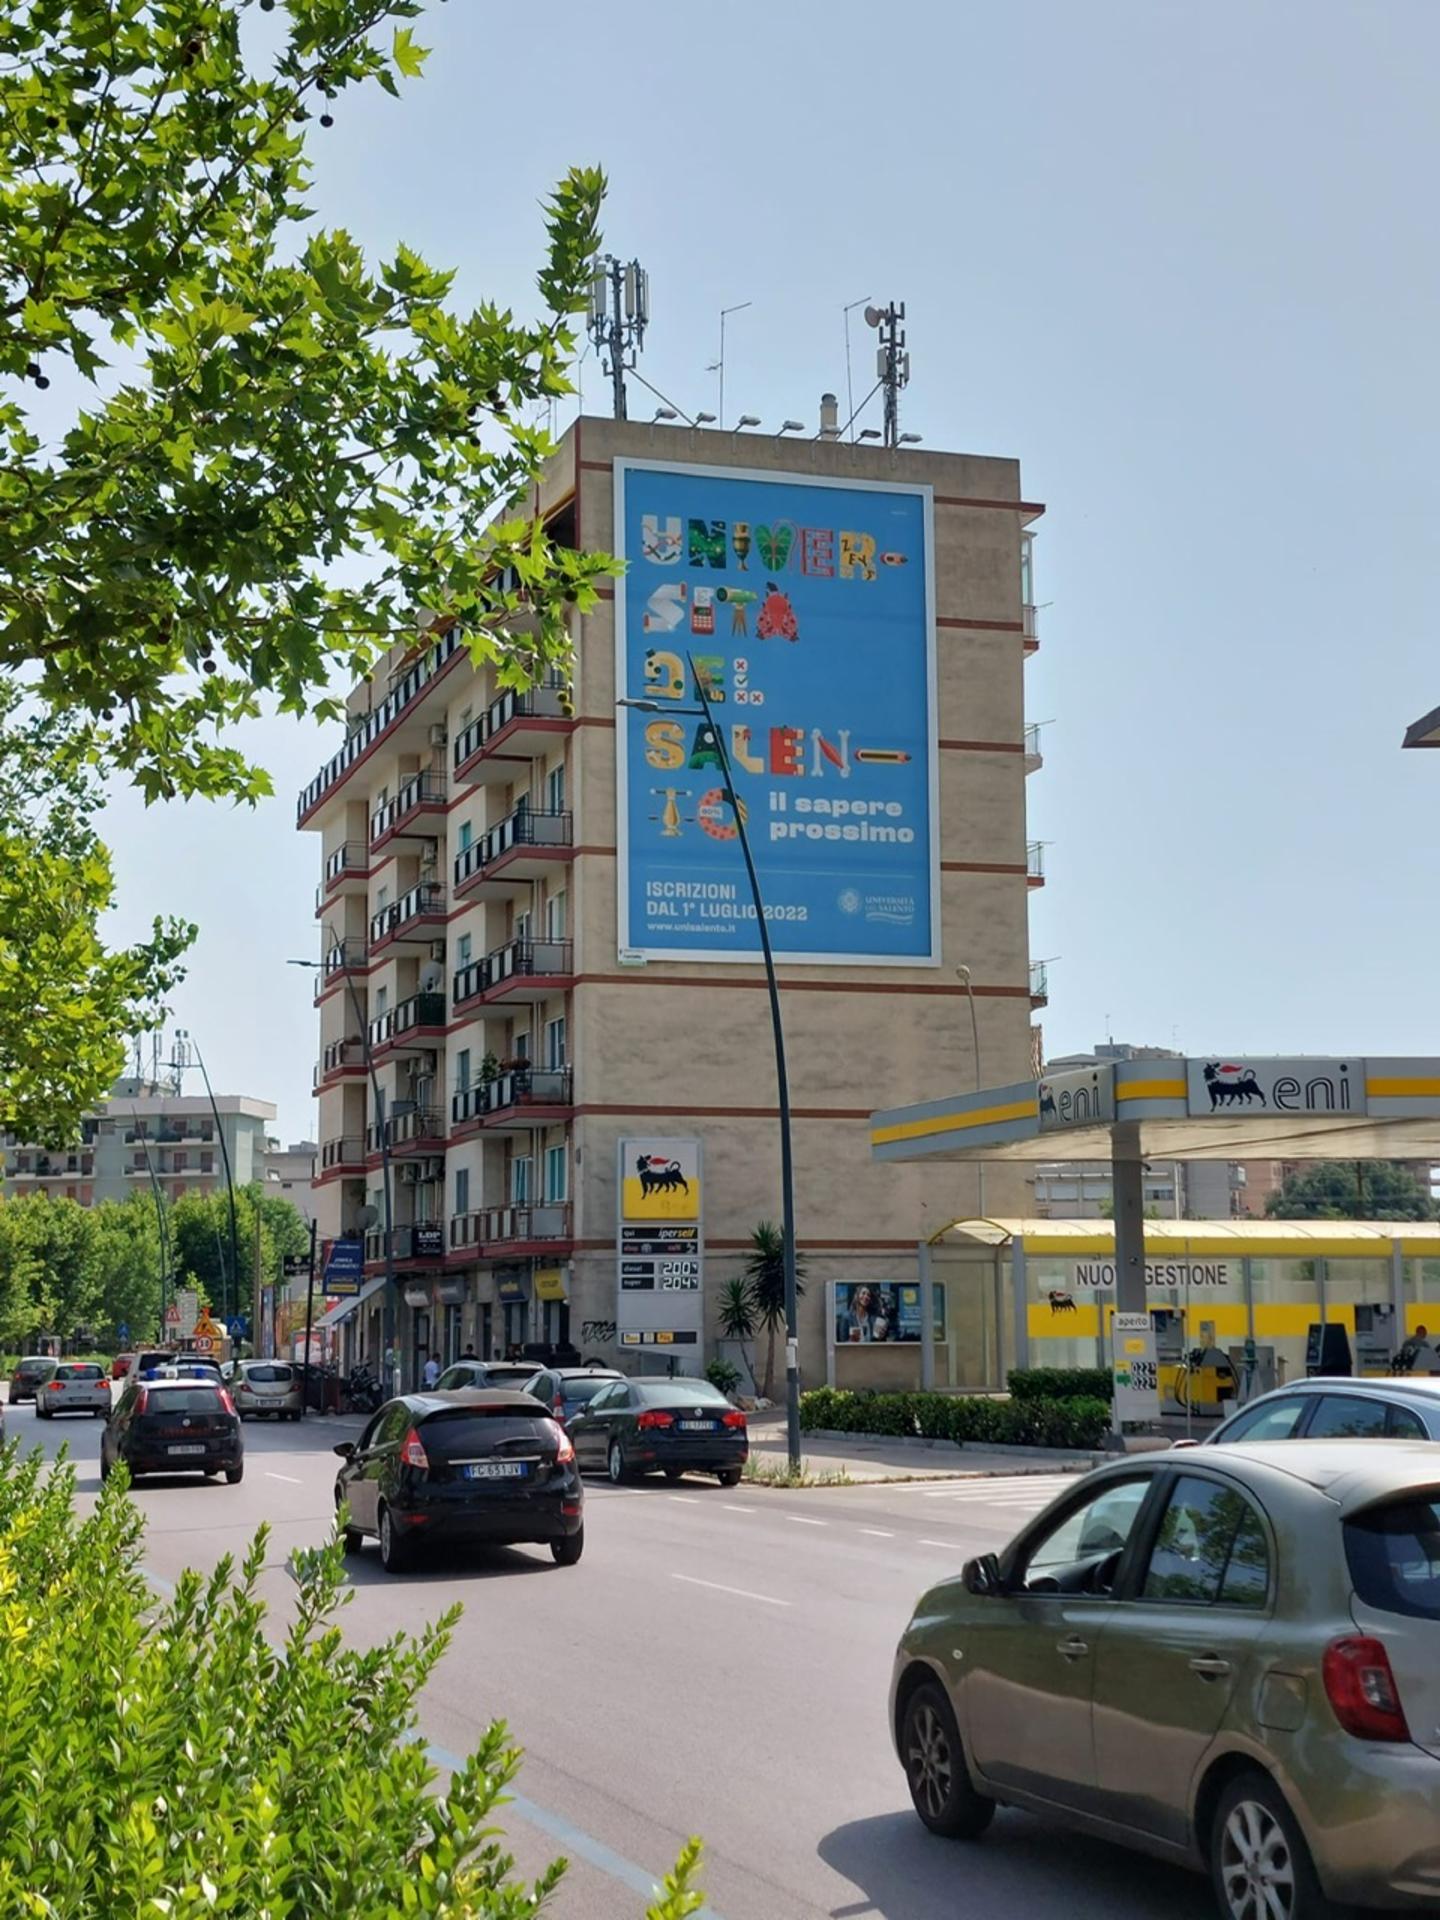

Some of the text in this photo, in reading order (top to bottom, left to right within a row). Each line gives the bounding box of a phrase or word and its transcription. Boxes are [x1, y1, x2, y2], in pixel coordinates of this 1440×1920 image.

[643, 648, 764, 706] DEL
[648, 786, 748, 842] TO
[769, 791, 903, 818] il sapere
[769, 821, 915, 843] prossimo
[646, 881, 736, 900] ISCRIZIONI
[646, 901, 679, 917] DAL
[700, 902, 758, 919] LUGLIO
[763, 904, 808, 921] 2022
[647, 921, 736, 934] www.unisalento.it
[1058, 1072, 1100, 1122] eni
[1272, 1063, 1350, 1111] eni
[1076, 1264, 1227, 1286] NUO GESTIONE
